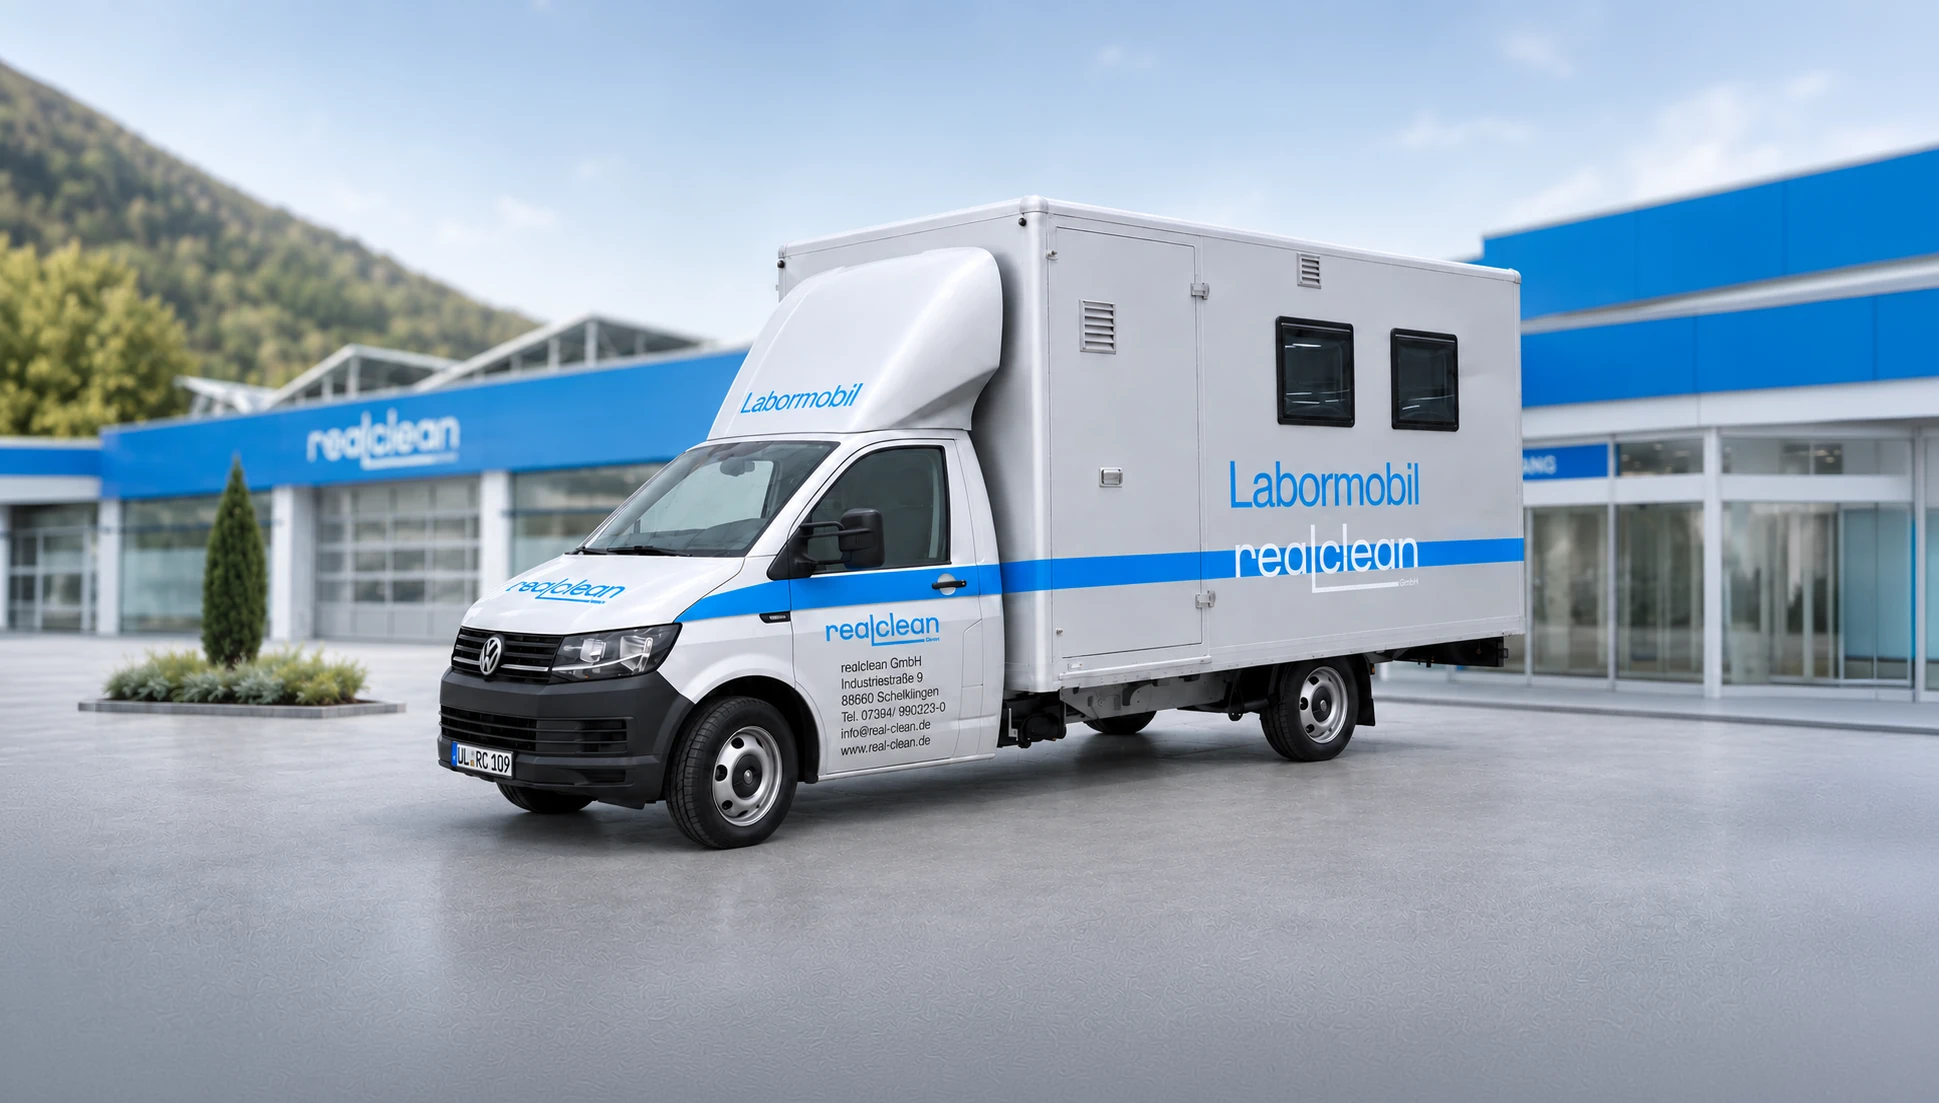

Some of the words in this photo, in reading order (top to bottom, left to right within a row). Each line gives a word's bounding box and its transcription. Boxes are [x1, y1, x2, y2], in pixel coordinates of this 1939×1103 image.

[740, 382, 863, 414] Labormobil
[306, 406, 461, 471] realclean
[1229, 460, 1419, 508] Labormobil
[1234, 523, 1419, 593] realclean
[505, 578, 626, 602] realclean
[825, 612, 940, 646] realclean
[841, 660, 888, 673] realclean
[890, 655, 922, 669] GmbH
[841, 672, 914, 690] Industriestraße
[916, 671, 924, 683] 9
[841, 691, 875, 706] 88660
[877, 687, 939, 703] Schelklingen
[841, 711, 859, 722] Tel.
[841, 719, 931, 739] info@real-clean.de
[840, 735, 931, 756] www.real-clean.de
[457, 746, 470, 766] UL
[475, 750, 489, 770] RC
[491, 753, 511, 773] 109
